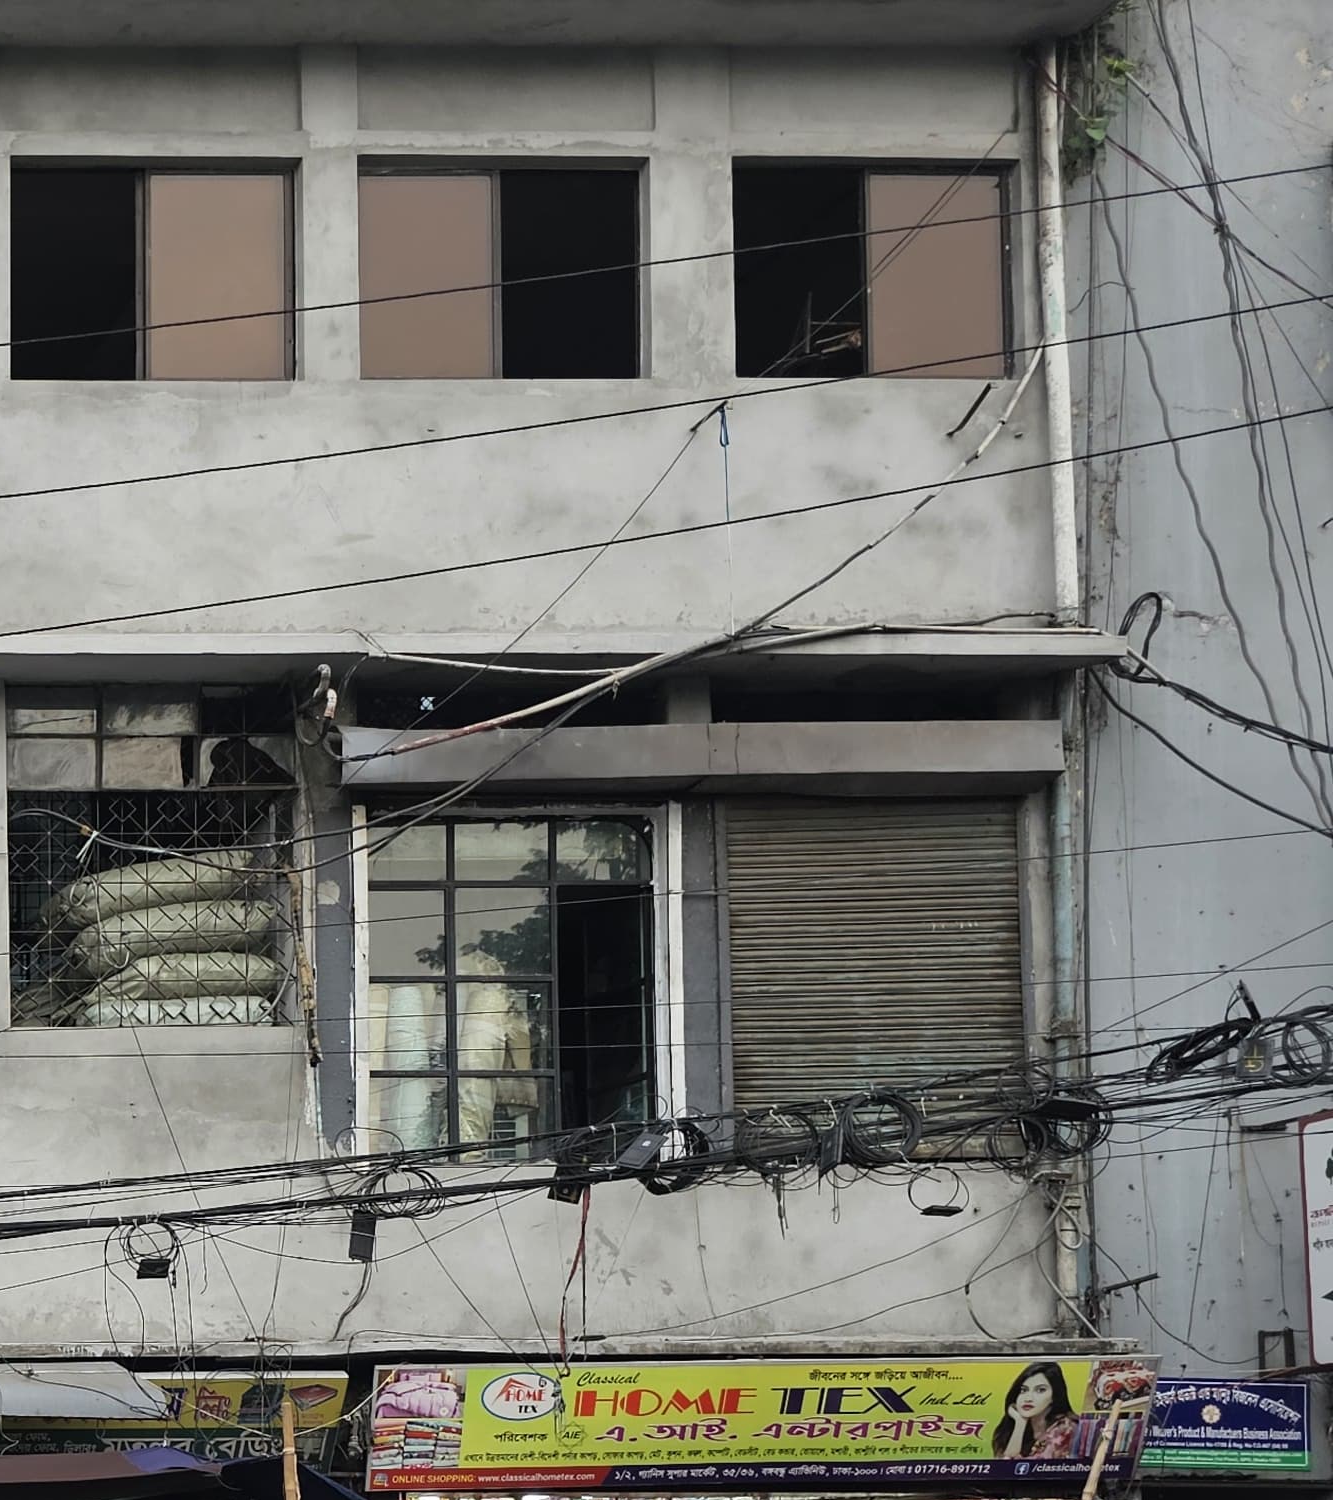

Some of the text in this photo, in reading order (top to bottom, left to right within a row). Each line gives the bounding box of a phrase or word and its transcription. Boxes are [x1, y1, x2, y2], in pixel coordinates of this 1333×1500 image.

[577, 1371, 640, 1387] Classical
[505, 1389, 547, 1414] HOME TEX
[573, 1387, 758, 1417] HOME
[771, 1385, 916, 1415] TEX
[494, 1430, 548, 1443] পরিবেশক
[751, 1414, 987, 1443] এন্টারপ্রাইজ
[914, 1463, 991, 1475] 01716-891712
[392, 1474, 427, 1484] ONLINE
[477, 1471, 595, 1483] www.classicalhometex.com
